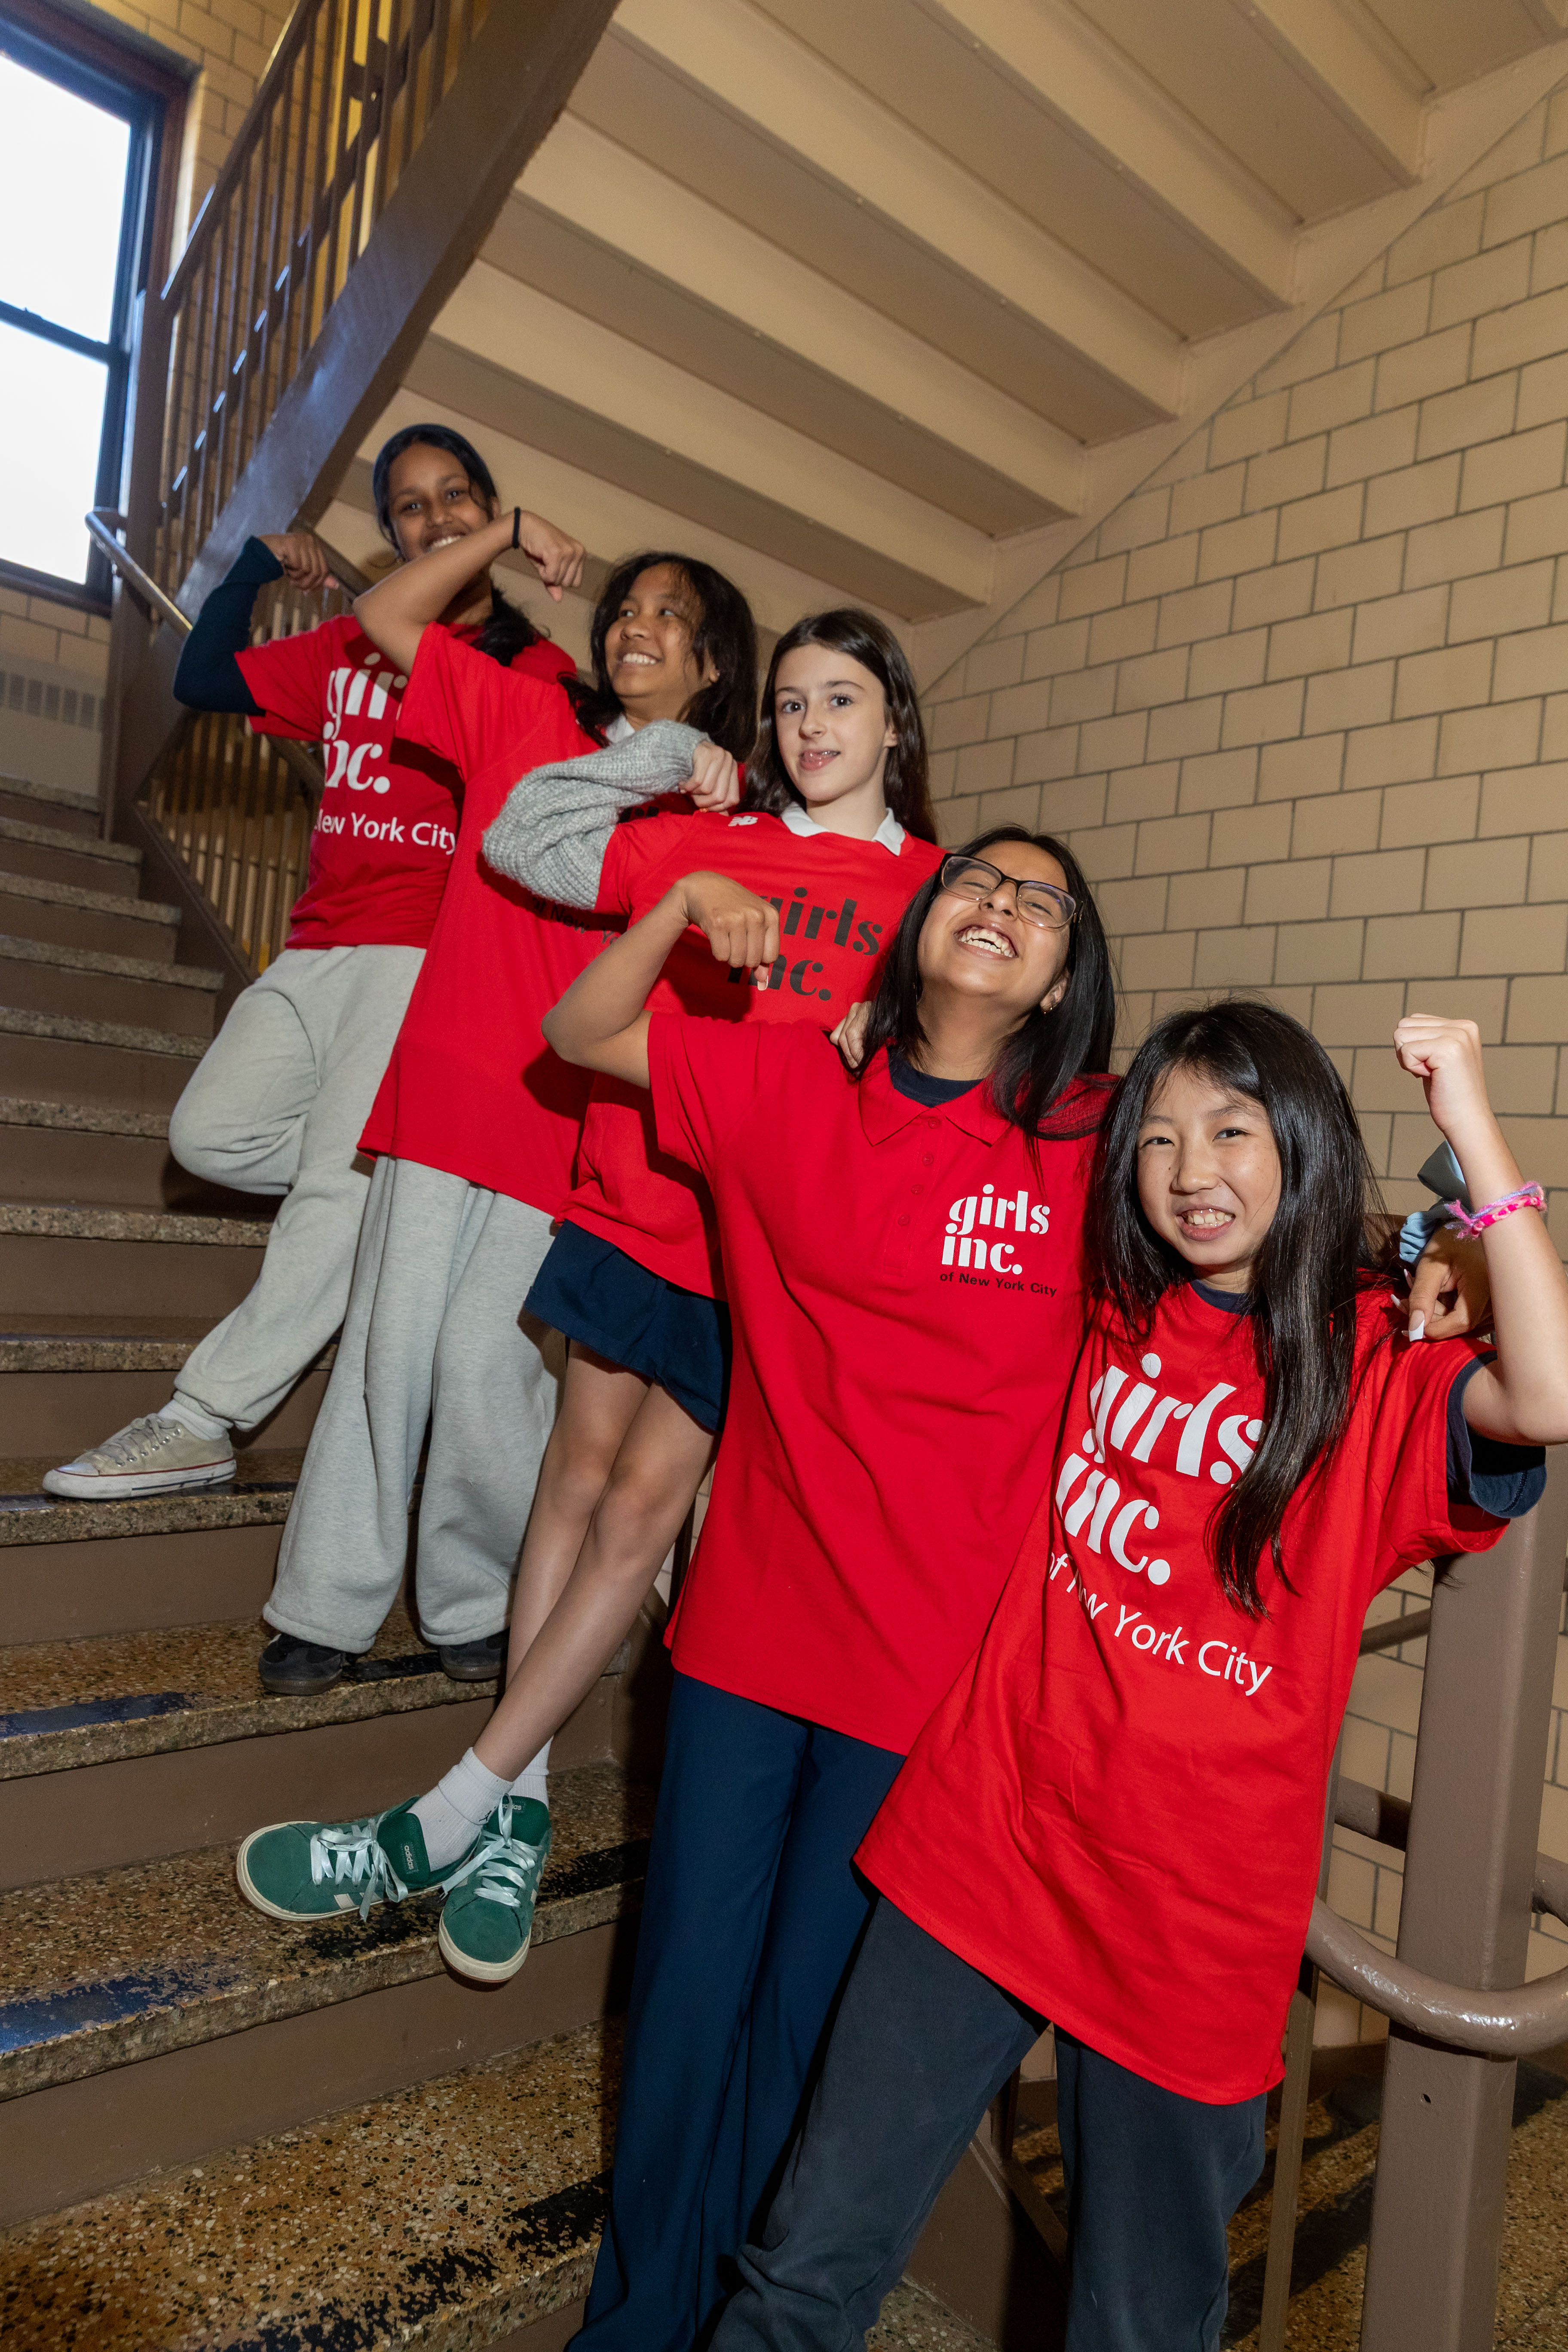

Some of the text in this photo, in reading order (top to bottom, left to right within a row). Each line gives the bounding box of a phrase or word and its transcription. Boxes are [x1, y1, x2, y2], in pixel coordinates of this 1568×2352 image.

[323, 740, 391, 794] nc.
[352, 812, 405, 843] York
[550, 903, 590, 934] New
[946, 1184, 1050, 1235] girls
[941, 1236, 1023, 1275] inc.
[940, 1272, 1057, 1297] of New York City
[1081, 1352, 1266, 1488] girls
[1055, 1453, 1171, 1585] inc.
[1066, 1569, 1109, 1620] Nw
[1114, 1605, 1190, 1665] York
[1197, 1641, 1273, 1697] City
[404, 1845, 414, 1870] adidas
